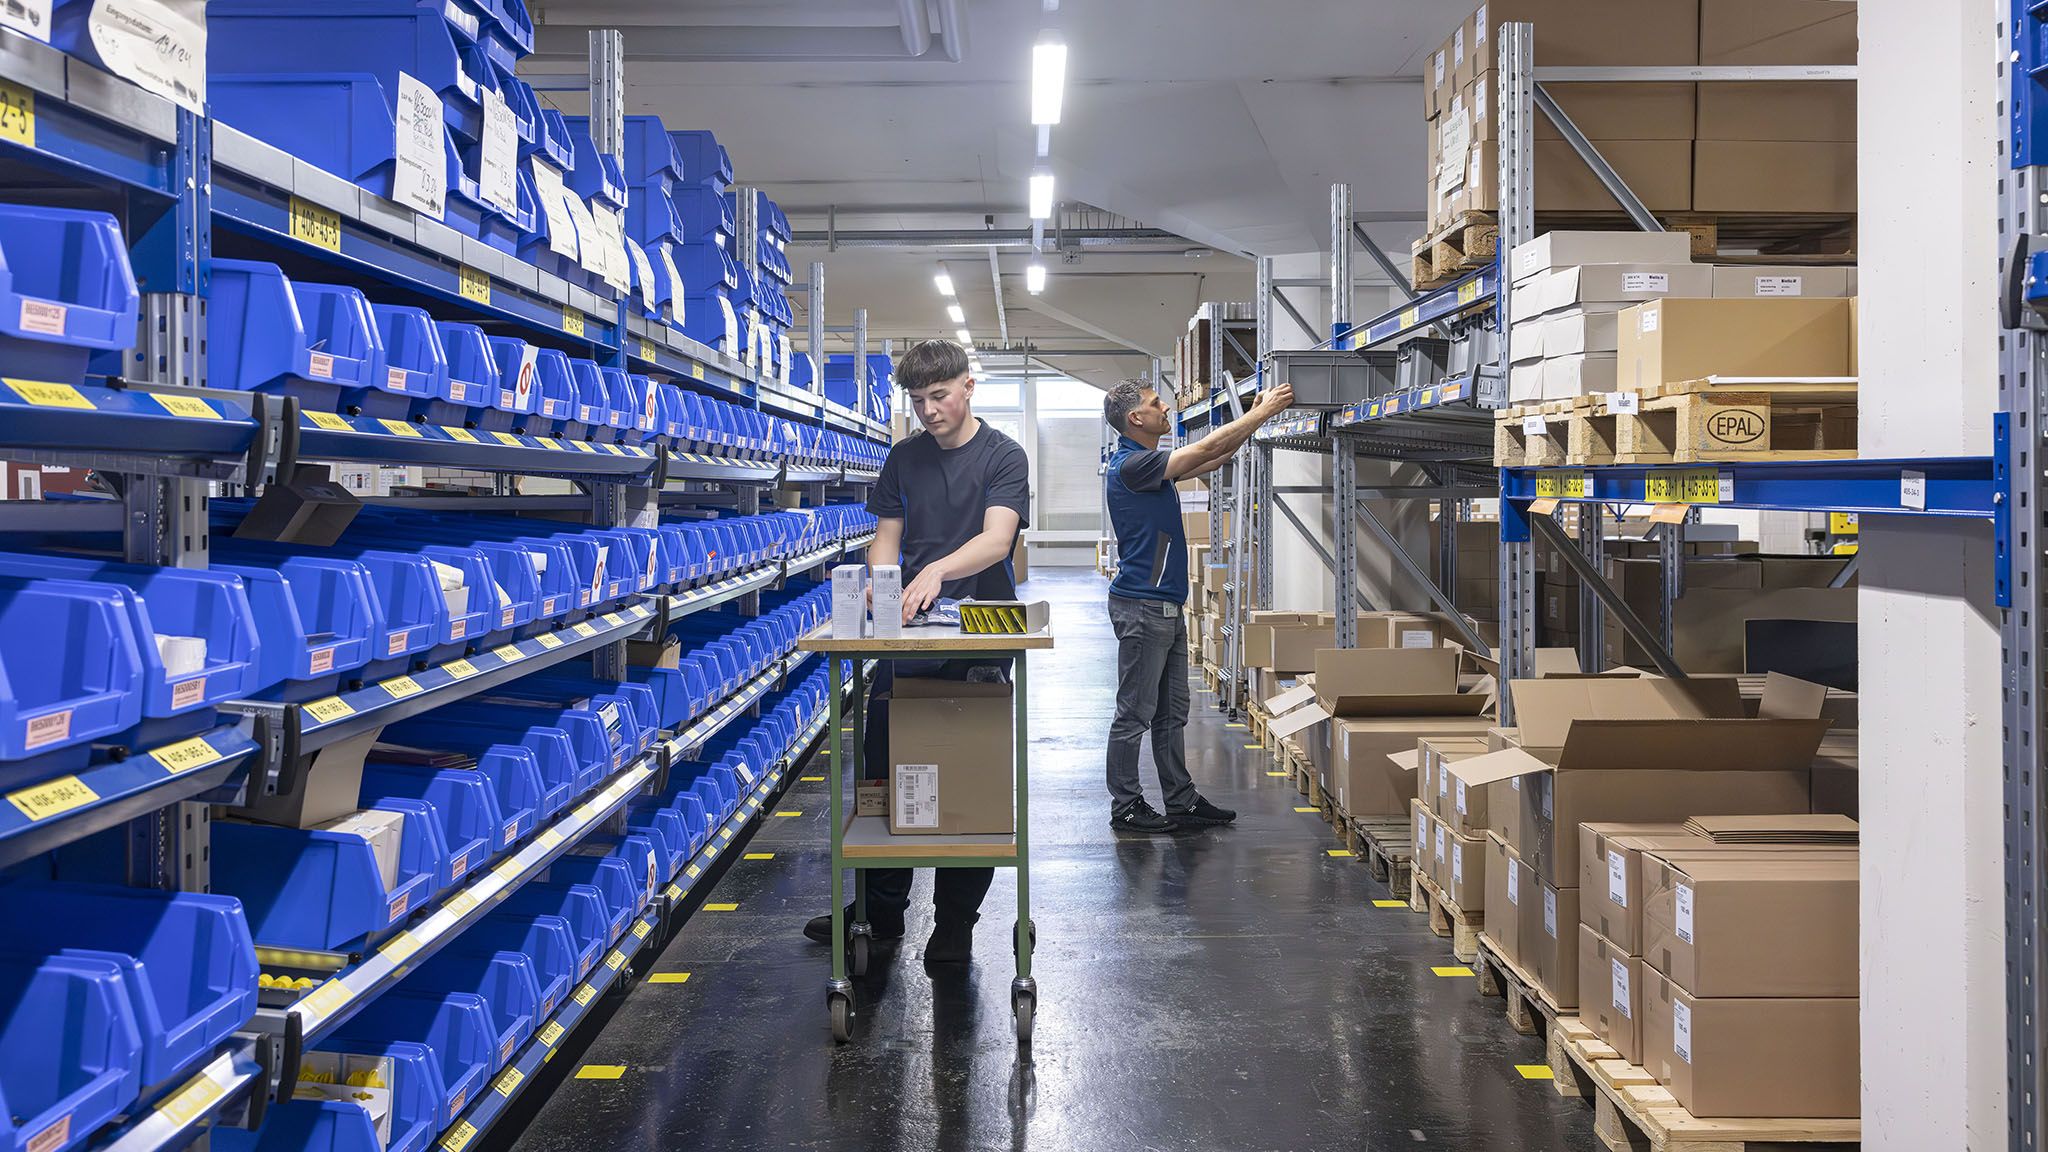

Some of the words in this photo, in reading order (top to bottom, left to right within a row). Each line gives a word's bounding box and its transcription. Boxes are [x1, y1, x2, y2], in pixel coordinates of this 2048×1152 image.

[301, 209, 337, 246] 406-43-5
[1716, 416, 1757, 436] EPAL
[1688, 475, 1716, 496] 405-33-3
